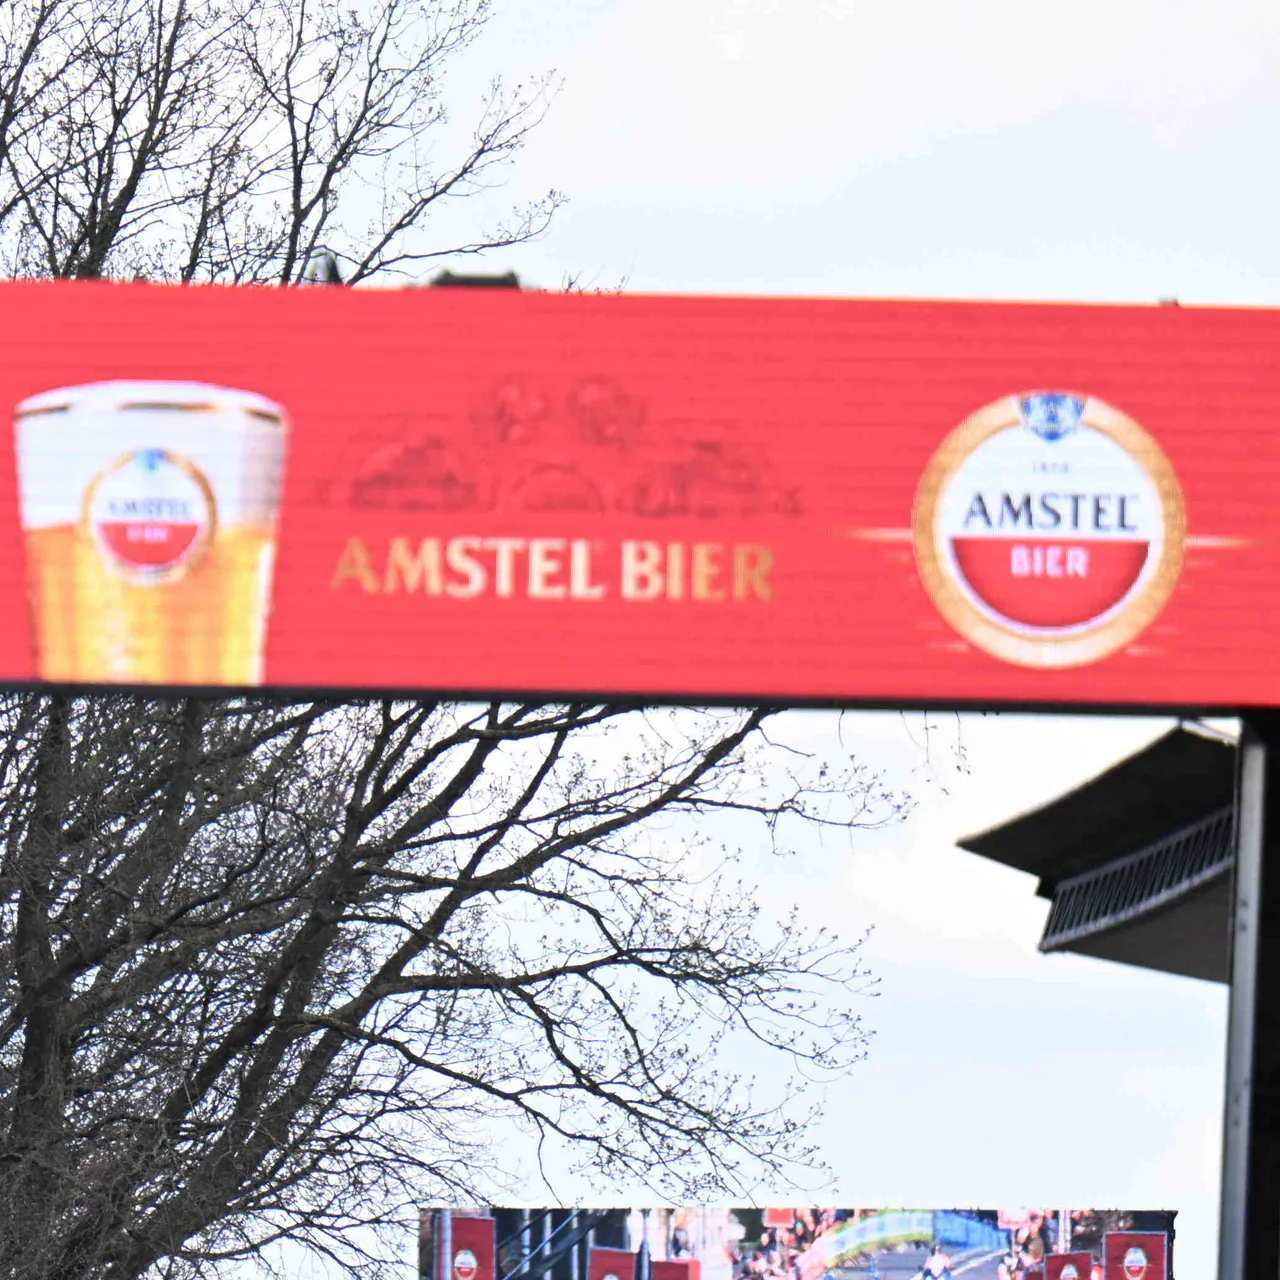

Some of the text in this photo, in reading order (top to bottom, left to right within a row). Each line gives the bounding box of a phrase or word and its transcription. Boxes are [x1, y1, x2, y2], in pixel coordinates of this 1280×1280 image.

[962, 491, 1139, 533] AMSTEL
[329, 536, 775, 603] AMSTEL BIER
[1010, 544, 1088, 579] BIER
